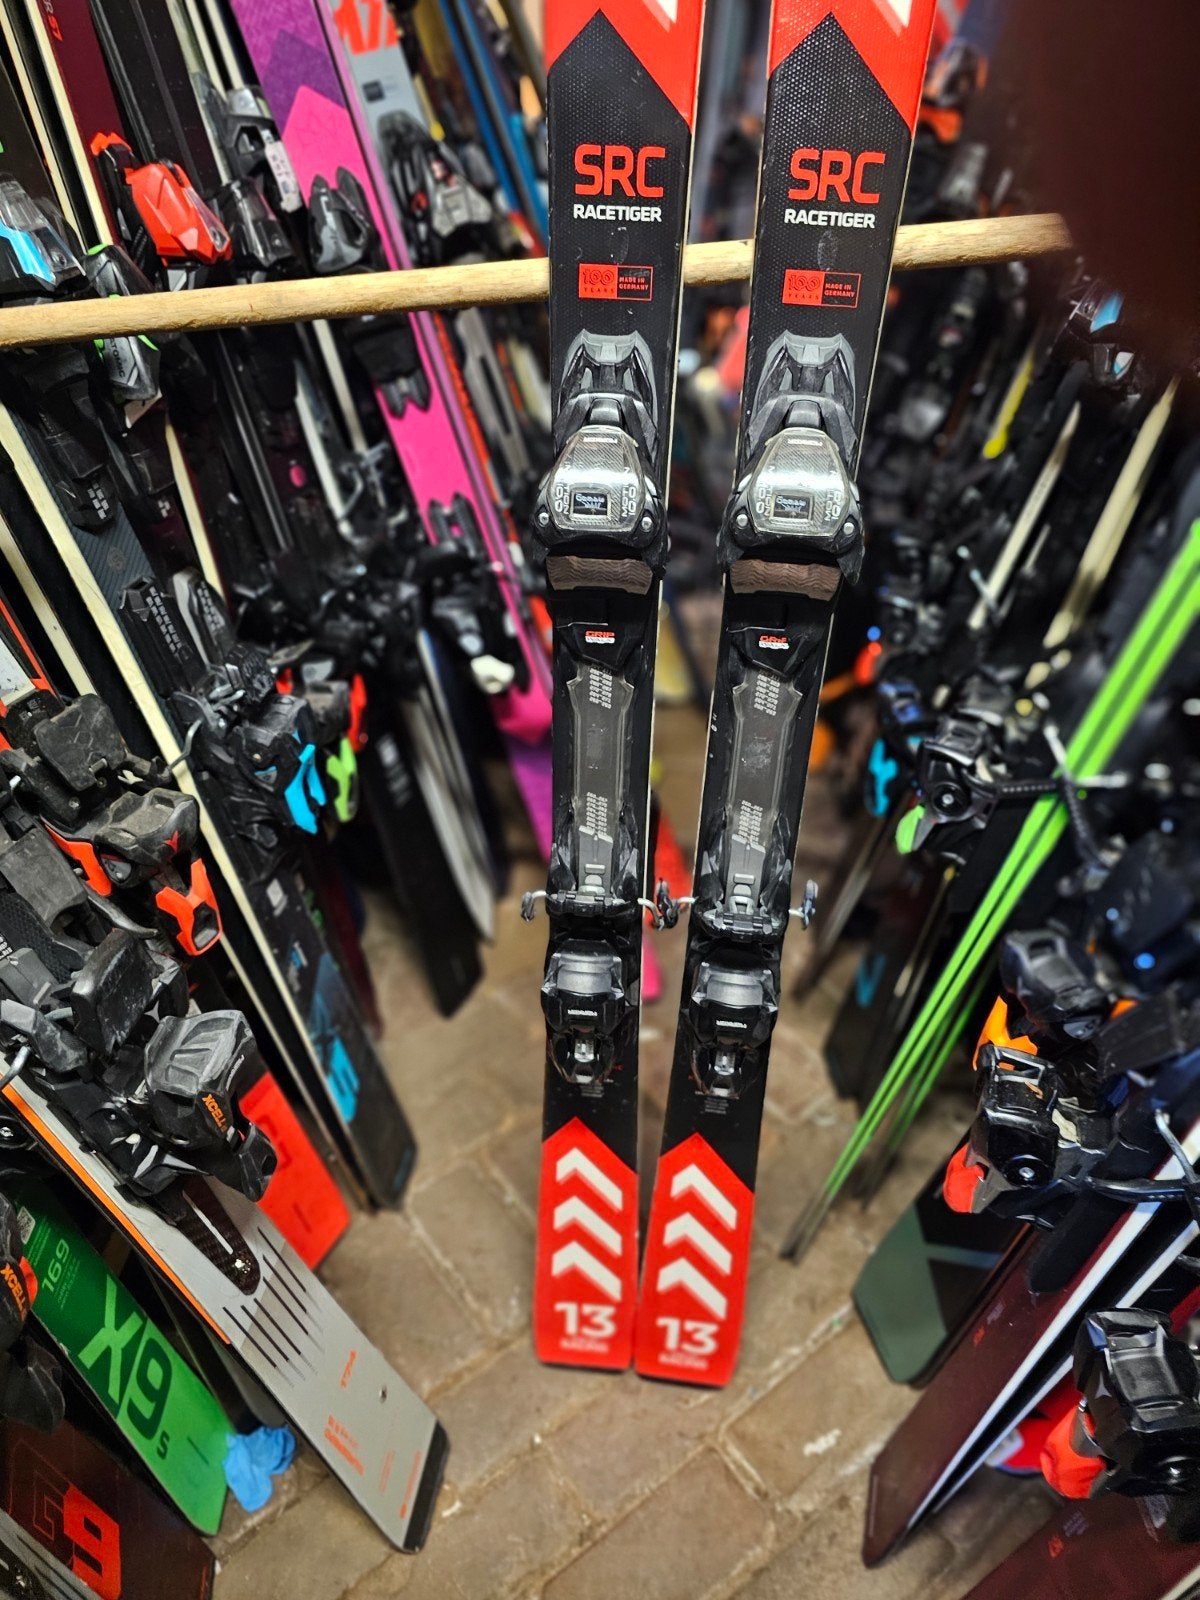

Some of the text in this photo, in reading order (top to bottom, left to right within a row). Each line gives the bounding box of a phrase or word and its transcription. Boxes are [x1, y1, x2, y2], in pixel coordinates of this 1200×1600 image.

[574, 143, 666, 198] SRC
[788, 147, 886, 204] SRC
[573, 203, 662, 222] RACETIGER
[784, 208, 876, 229] RACETIGER
[582, 268, 615, 286] 100
[619, 276, 637, 284] MADE
[787, 274, 821, 292] 100
[618, 283, 649, 291] GERMANY
[824, 283, 843, 291] MADE
[824, 289, 856, 298] GERMANY
[41, 1238, 70, 1293] 169
[553, 1301, 617, 1339] 13
[655, 1315, 720, 1356] 13
